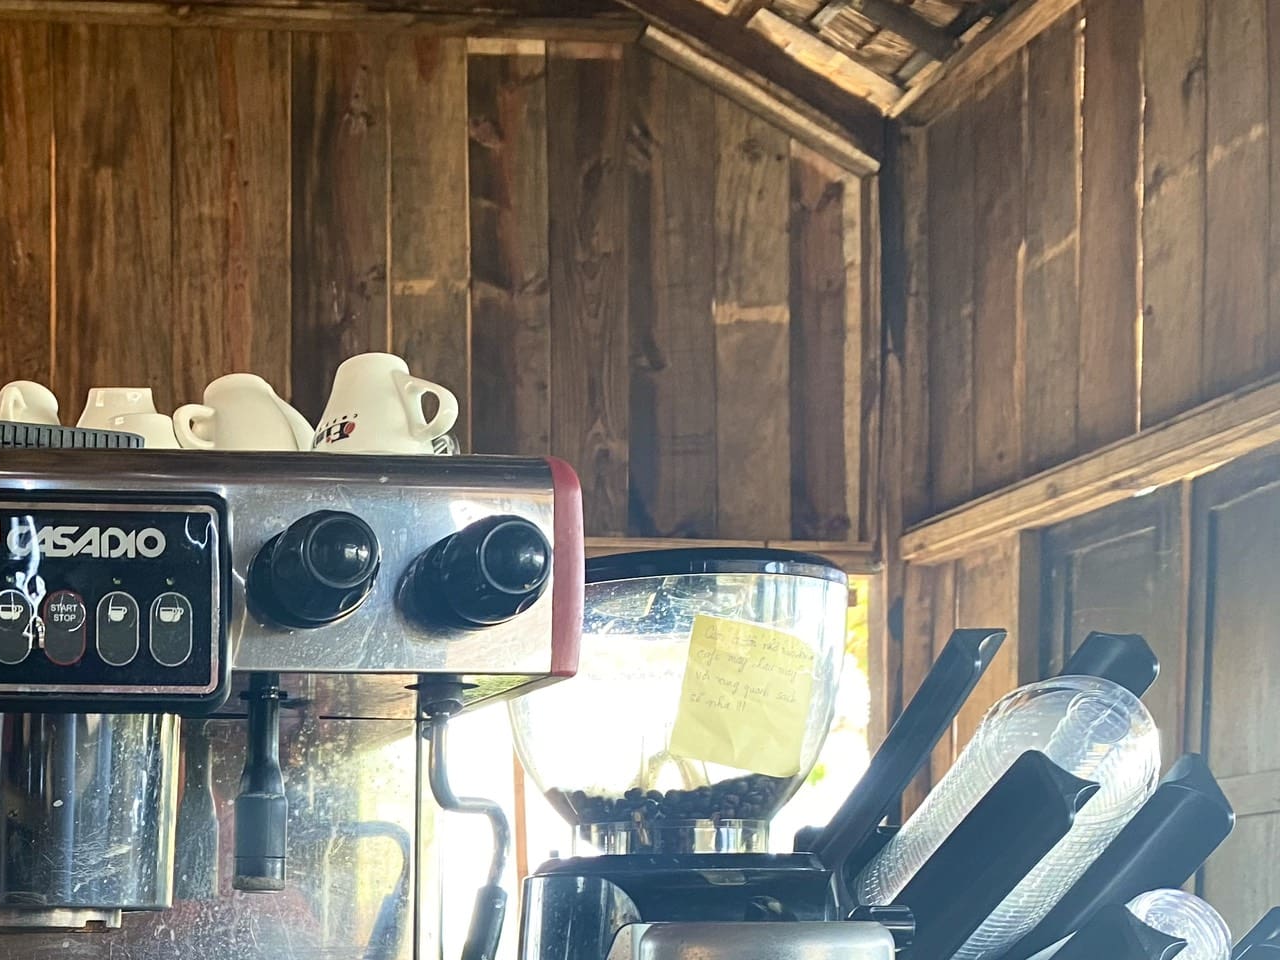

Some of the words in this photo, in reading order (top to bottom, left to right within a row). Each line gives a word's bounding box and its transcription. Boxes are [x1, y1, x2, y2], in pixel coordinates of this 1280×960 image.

[6, 526, 166, 558] CASADIO
[50, 603, 78, 613] START
[53, 613, 76, 622] STOP
